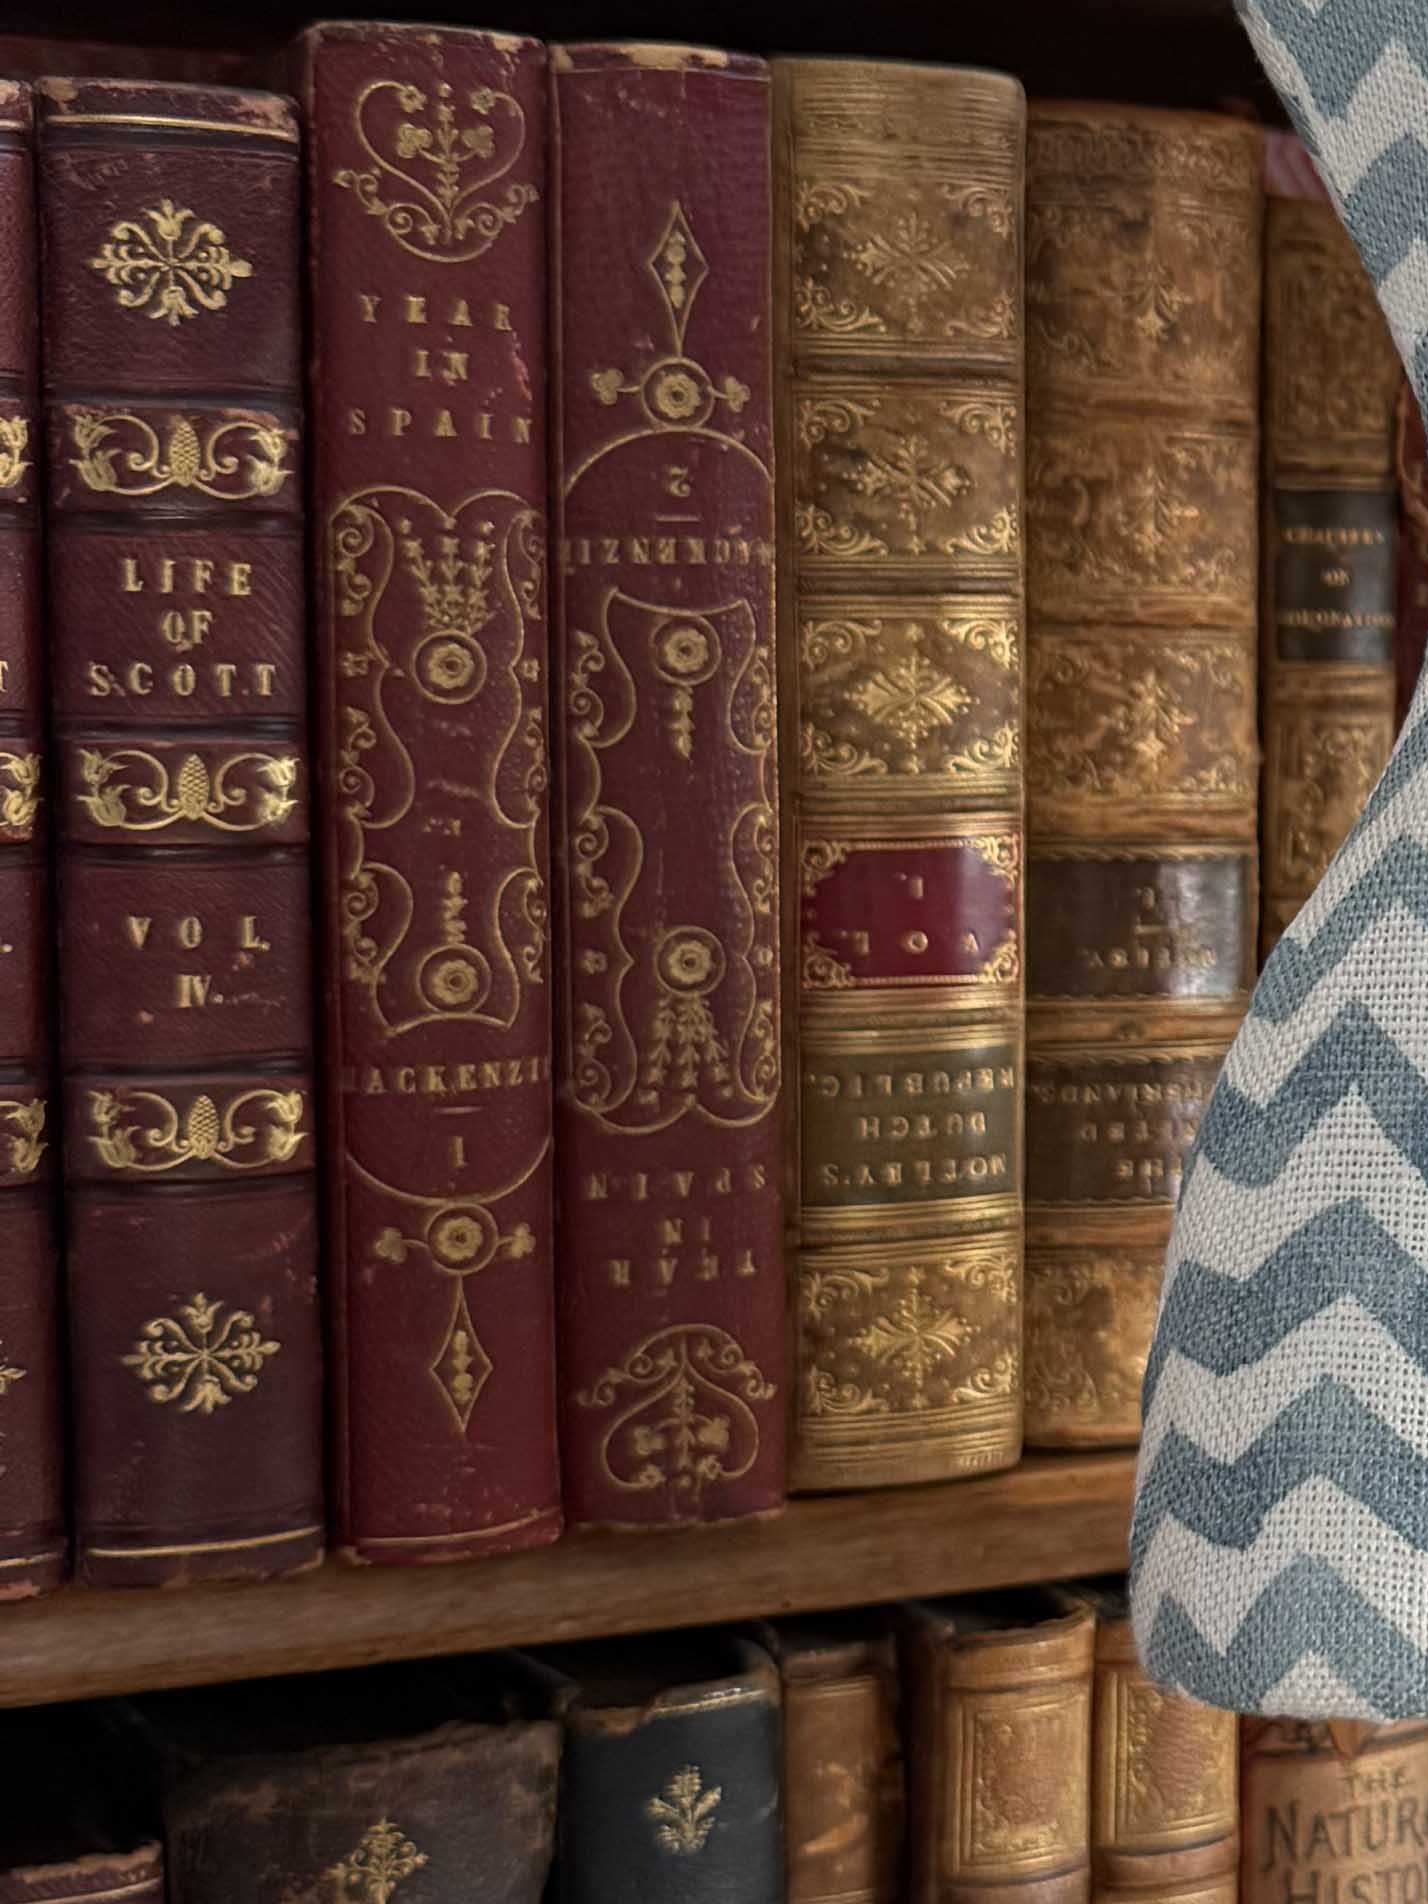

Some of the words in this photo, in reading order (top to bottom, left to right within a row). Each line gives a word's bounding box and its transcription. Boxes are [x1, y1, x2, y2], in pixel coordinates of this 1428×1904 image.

[357, 295, 513, 332] YEAR
[414, 350, 471, 382] IN
[348, 408, 533, 444] SPAIN
[124, 559, 255, 598] LIFE
[161, 609, 215, 651] OF
[89, 663, 277, 698] SCOTT
[128, 914, 272, 953] VOL.
[342, 1055, 552, 1095] ACKENZI
[858, 1112, 987, 1139] DUTCH
[585, 1163, 768, 1201] SPAIN
[820, 1153, 1007, 1186] MOTLEY'S
[660, 1216, 712, 1246] IN
[1341, 1765, 1411, 1800] THE
